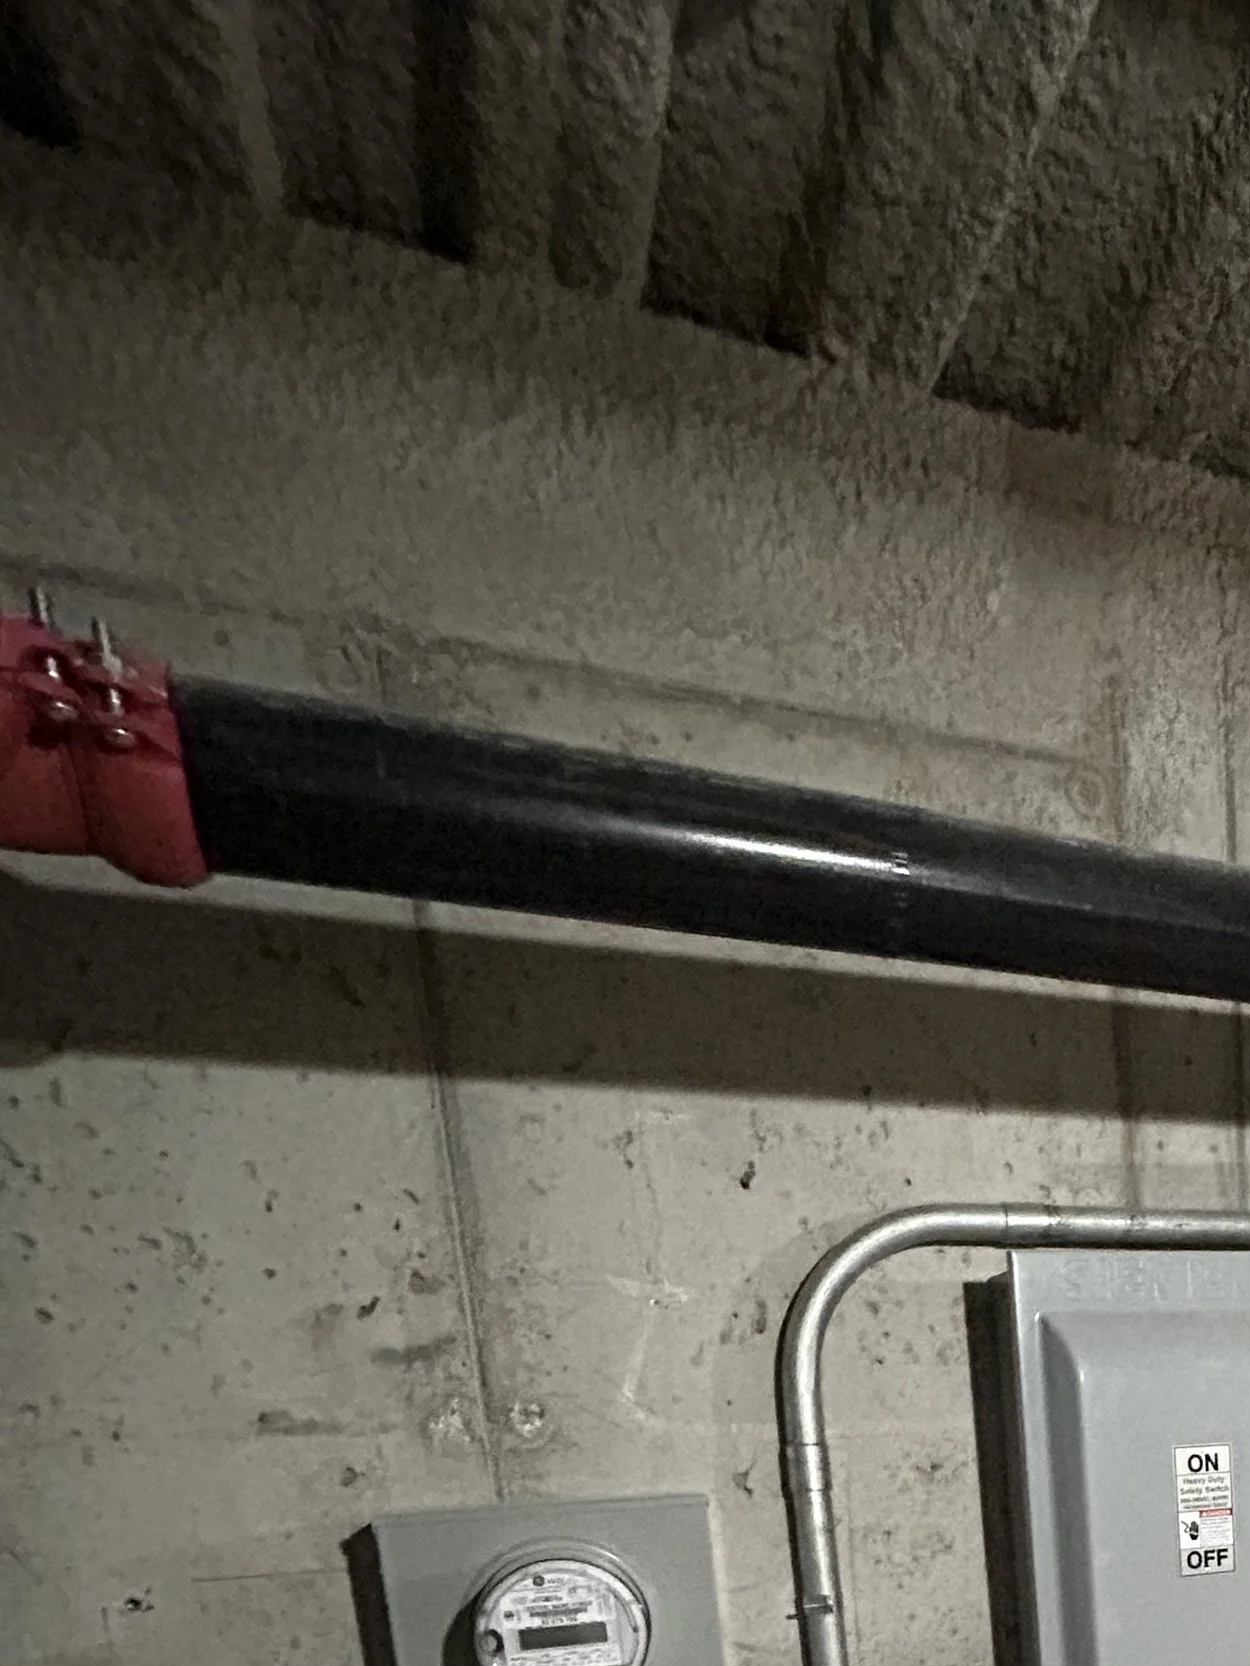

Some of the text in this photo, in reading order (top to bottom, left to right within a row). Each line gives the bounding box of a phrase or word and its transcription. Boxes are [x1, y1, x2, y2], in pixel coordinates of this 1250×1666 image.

[1187, 1453, 1218, 1472] ON
[1183, 1477, 1205, 1486] Heavy
[1187, 1549, 1228, 1569] OFF
